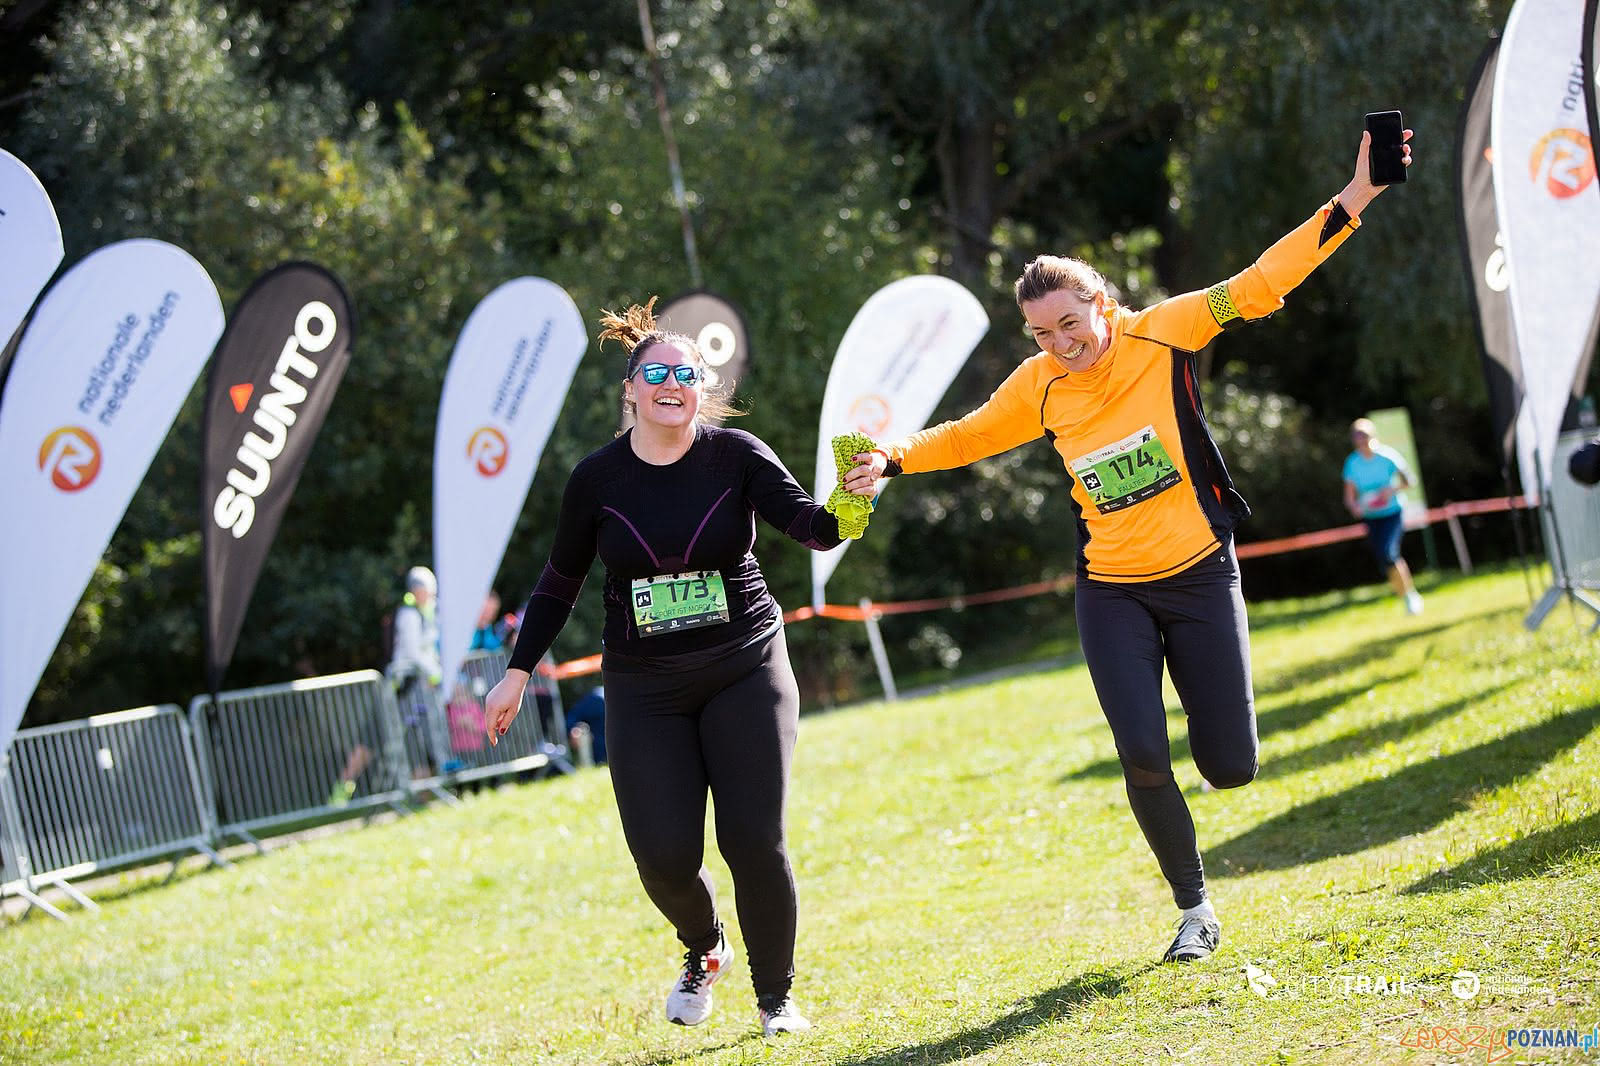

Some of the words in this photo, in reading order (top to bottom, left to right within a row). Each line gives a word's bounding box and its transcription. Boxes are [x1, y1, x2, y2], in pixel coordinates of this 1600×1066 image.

[77, 311, 140, 415] nationale
[99, 289, 181, 427] nederlanden
[214, 300, 337, 539] SUUNTO
[1108, 448, 1154, 480] 174
[666, 579, 709, 603] 173
